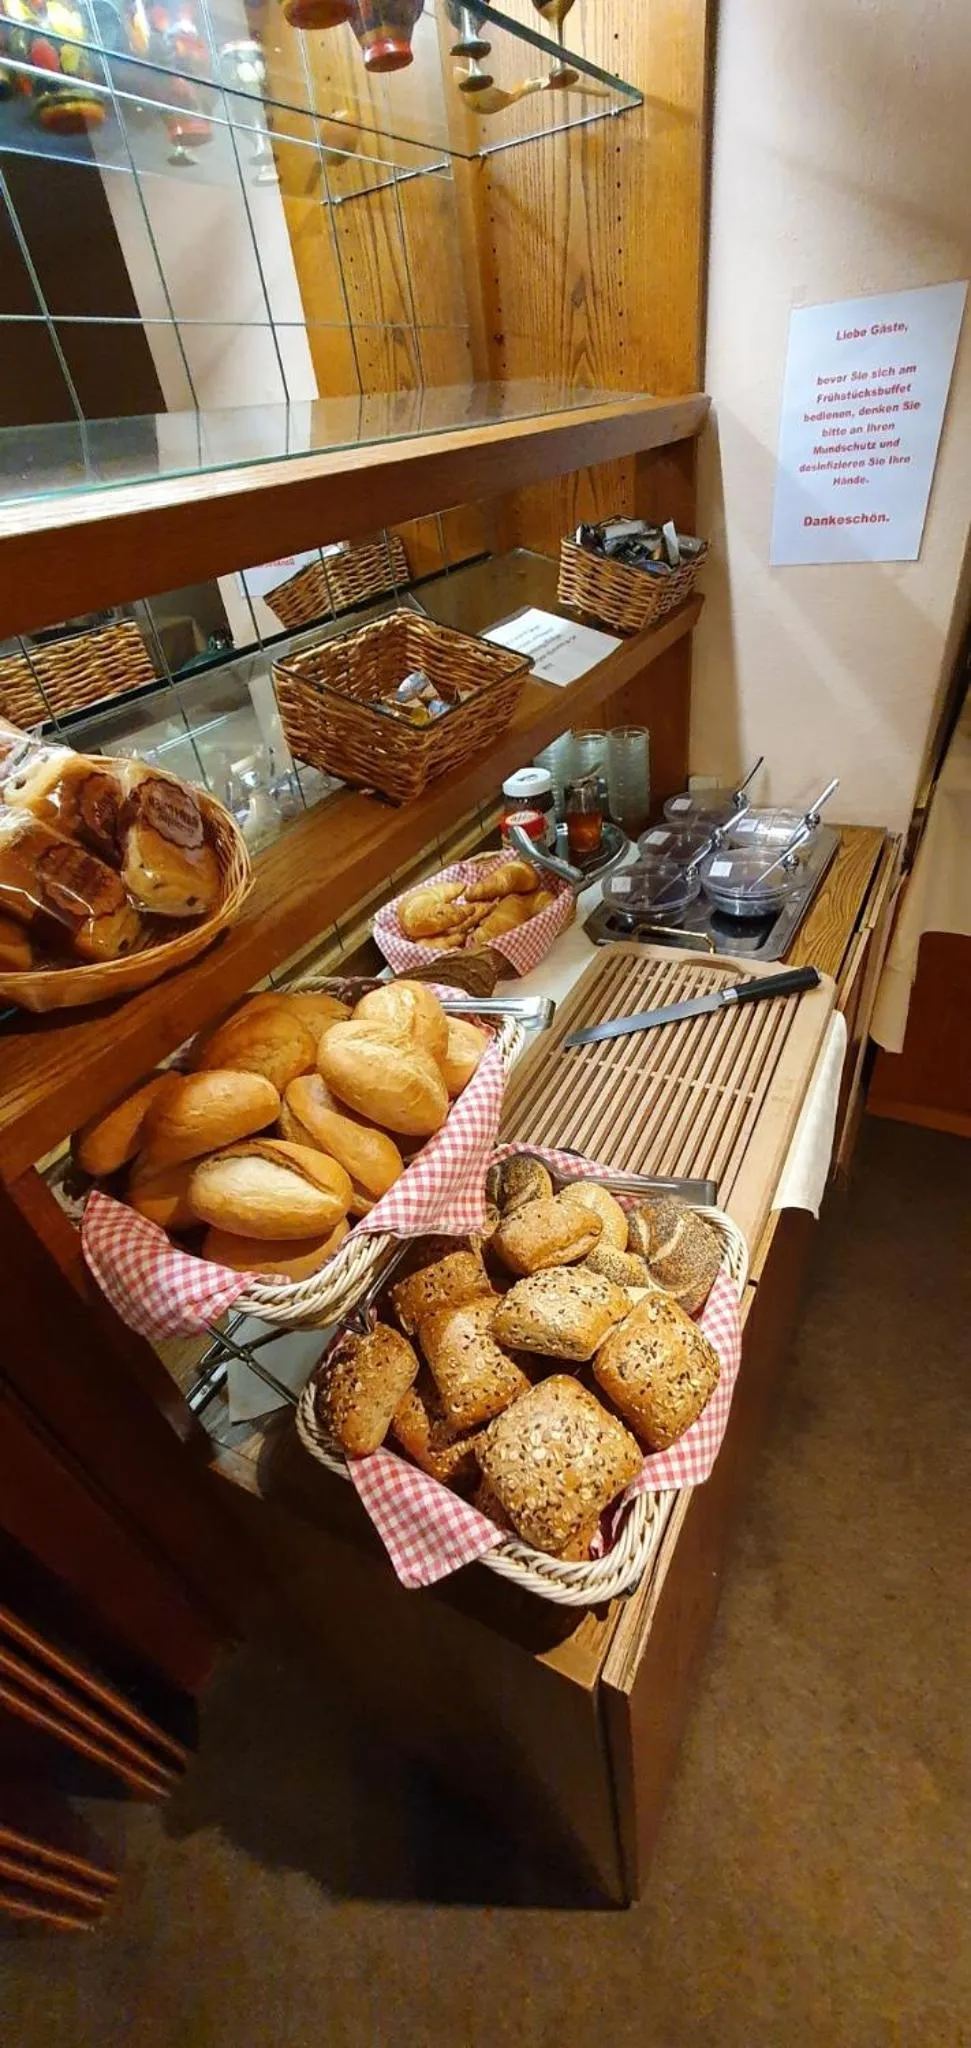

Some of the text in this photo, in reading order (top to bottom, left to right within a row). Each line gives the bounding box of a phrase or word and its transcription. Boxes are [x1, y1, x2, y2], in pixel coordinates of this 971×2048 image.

[836, 321, 908, 340] Liebe Gäste,
[816, 365, 917, 385] bevor Sie sich am
[803, 401, 921, 422] bedienen, denken Sie
[822, 422, 895, 437] bitte an Ihren
[813, 438, 901, 454] Mundschutz und
[799, 455, 911, 472] desinfizieren Sie Ihre
[803, 513, 890, 527] Dankeschön.
